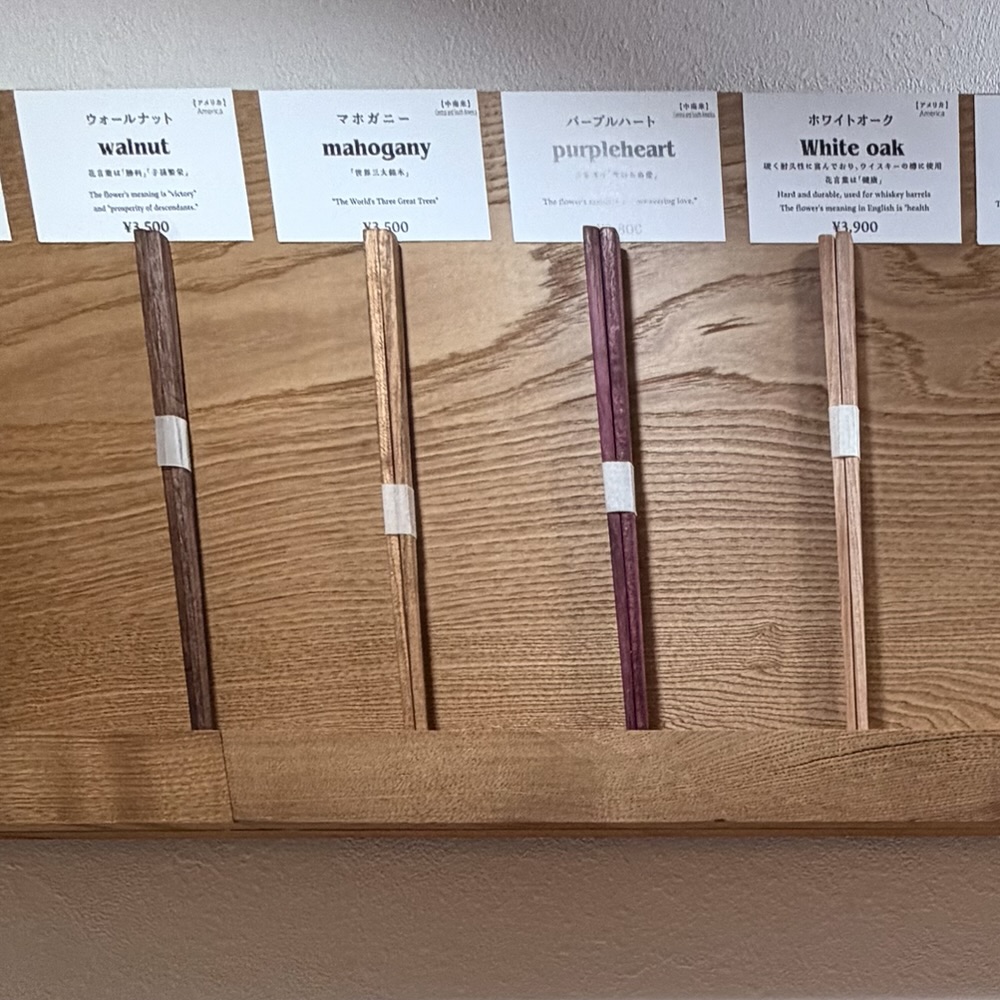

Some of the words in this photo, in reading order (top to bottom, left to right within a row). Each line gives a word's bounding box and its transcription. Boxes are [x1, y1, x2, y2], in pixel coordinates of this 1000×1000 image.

[86, 112, 172, 125] ウォールナット
[337, 112, 409, 125] マホガニー
[919, 109, 945, 118] America
[567, 115, 655, 128] パープルハート
[809, 114, 892, 126] ホワイトオーク
[98, 138, 170, 155] walnut
[323, 139, 430, 160] mahogany
[553, 140, 676, 162] purpleheart
[800, 138, 859, 156] White
[866, 139, 904, 156] oak
[89, 190, 102, 199] The
[104, 190, 129, 199] flower's
[131, 191, 159, 200] meaning
[160, 190, 166, 198] is
[168, 189, 196, 199] "victory"
[778, 190, 796, 199] Hard
[798, 189, 811, 199] and
[812, 189, 842, 199] durable,
[844, 189, 860, 199] used
[862, 189, 873, 199] for
[875, 190, 904, 200] whiskey
[906, 189, 930, 199] barrels
[332, 197, 348, 206] "The
[350, 197, 375, 206] World's
[376, 197, 396, 206] Three
[398, 197, 416, 205] Great
[418, 196, 438, 205] Trees"
[94, 204, 106, 213] and
[107, 204, 144, 214] "prosperity
[146, 203, 152, 212] of
[154, 202, 198, 212] descendants."
[780, 203, 794, 213] The
[796, 203, 824, 213] flower's
[826, 204, 856, 214] meaning
[858, 203, 866, 213] in
[868, 204, 894, 213] English
[896, 203, 902, 212] is
[904, 203, 929, 212] "health
[123, 221, 169, 233] ¥3500
[363, 222, 408, 233] ¥3500
